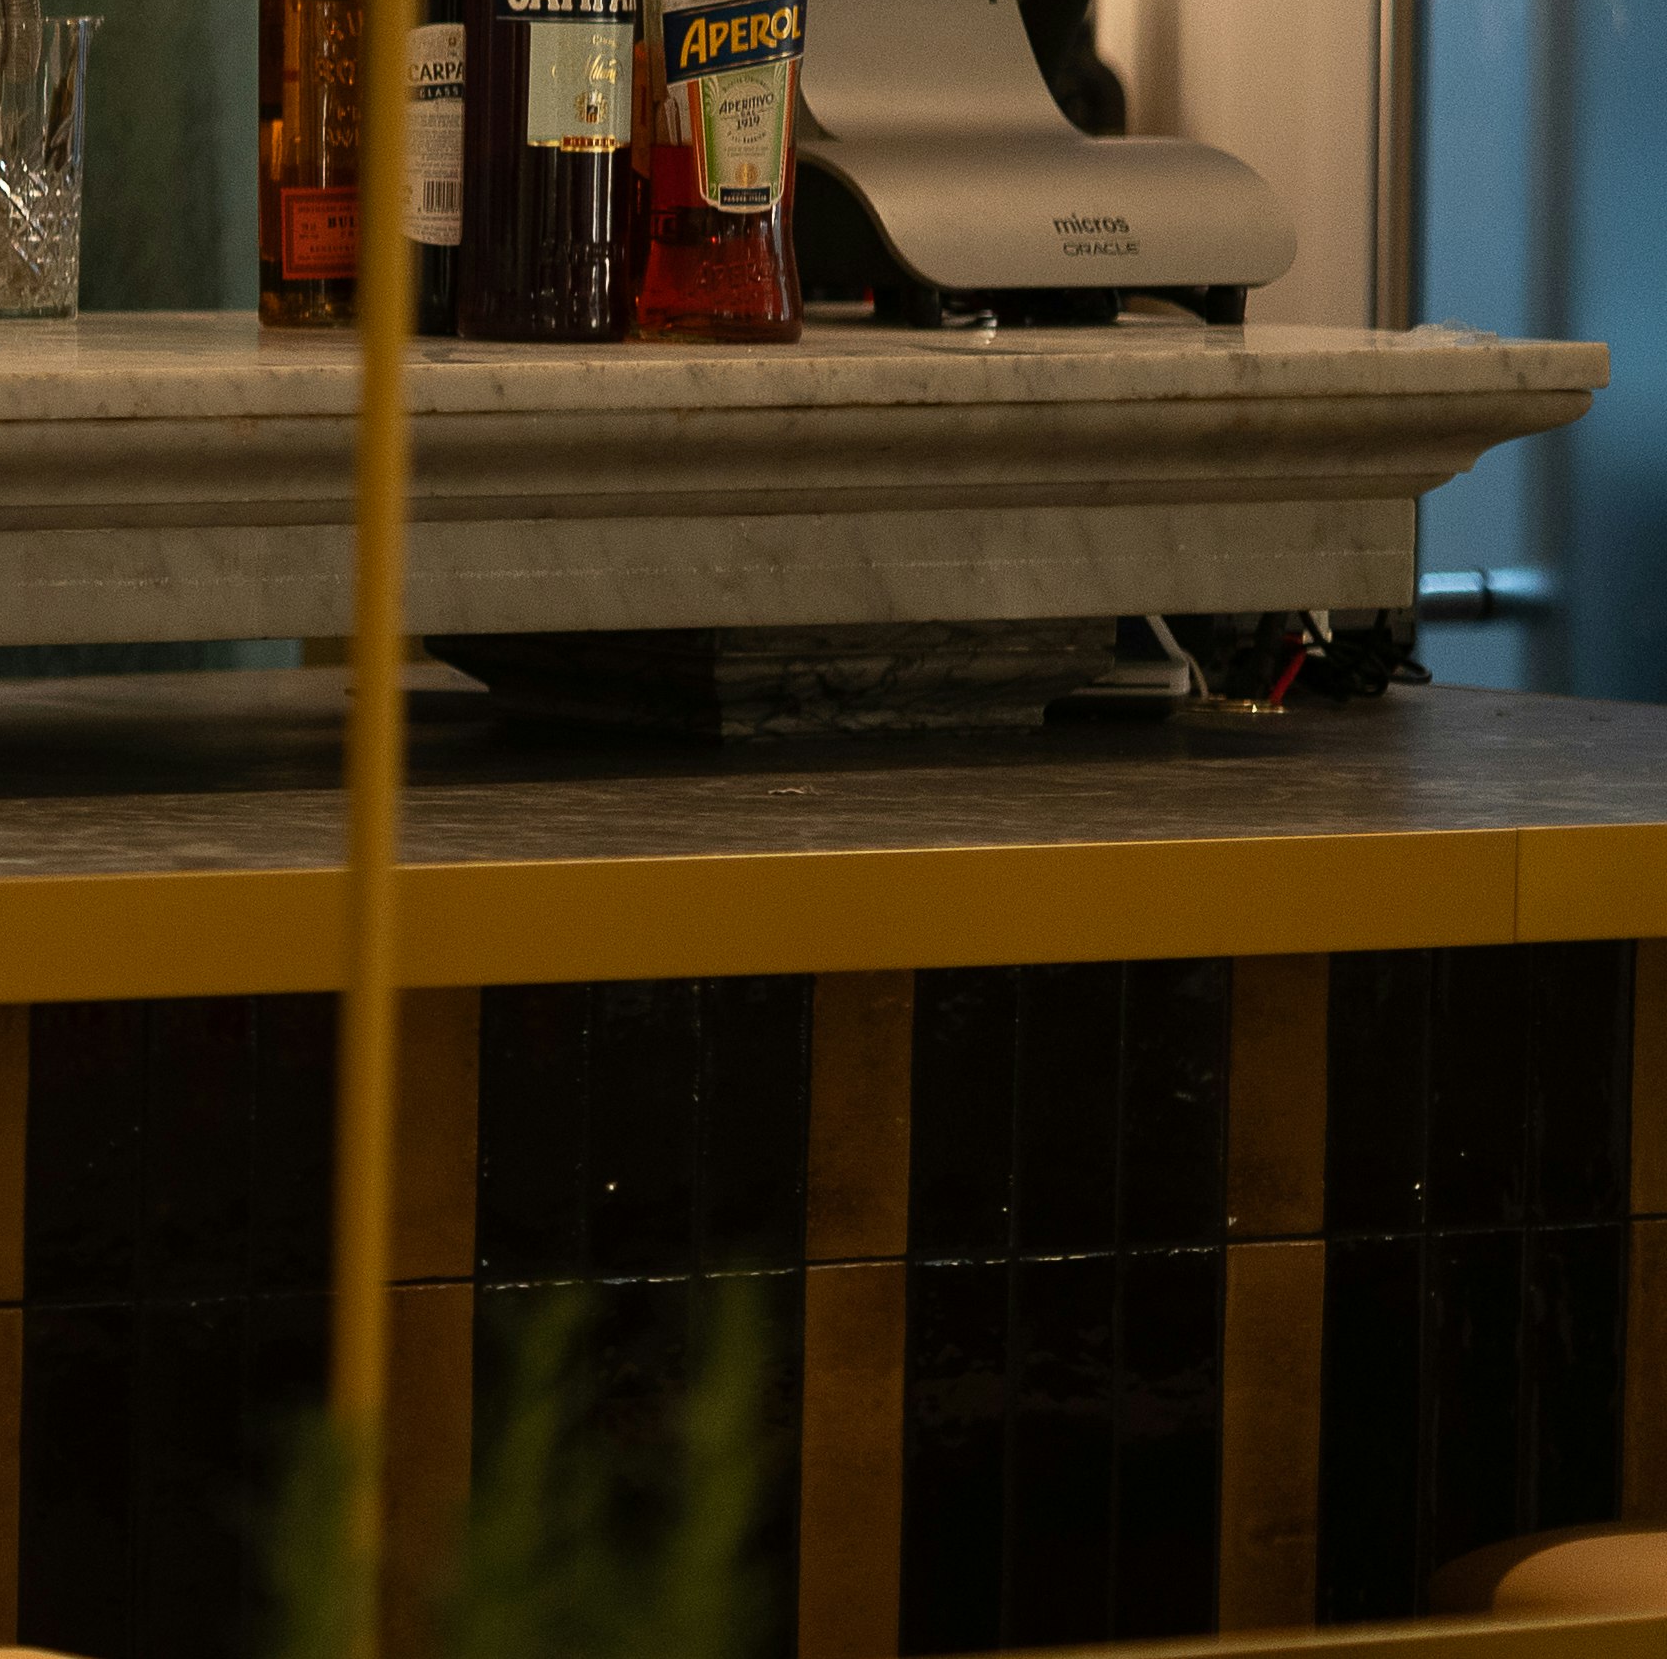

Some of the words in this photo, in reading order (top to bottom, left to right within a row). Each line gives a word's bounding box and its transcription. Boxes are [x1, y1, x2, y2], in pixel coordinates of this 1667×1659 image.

[679, 5, 802, 69] APEROL
[736, 116, 761, 131] 1919
[1052, 212, 1130, 234] micros
[1062, 242, 1140, 258] ORACLE
